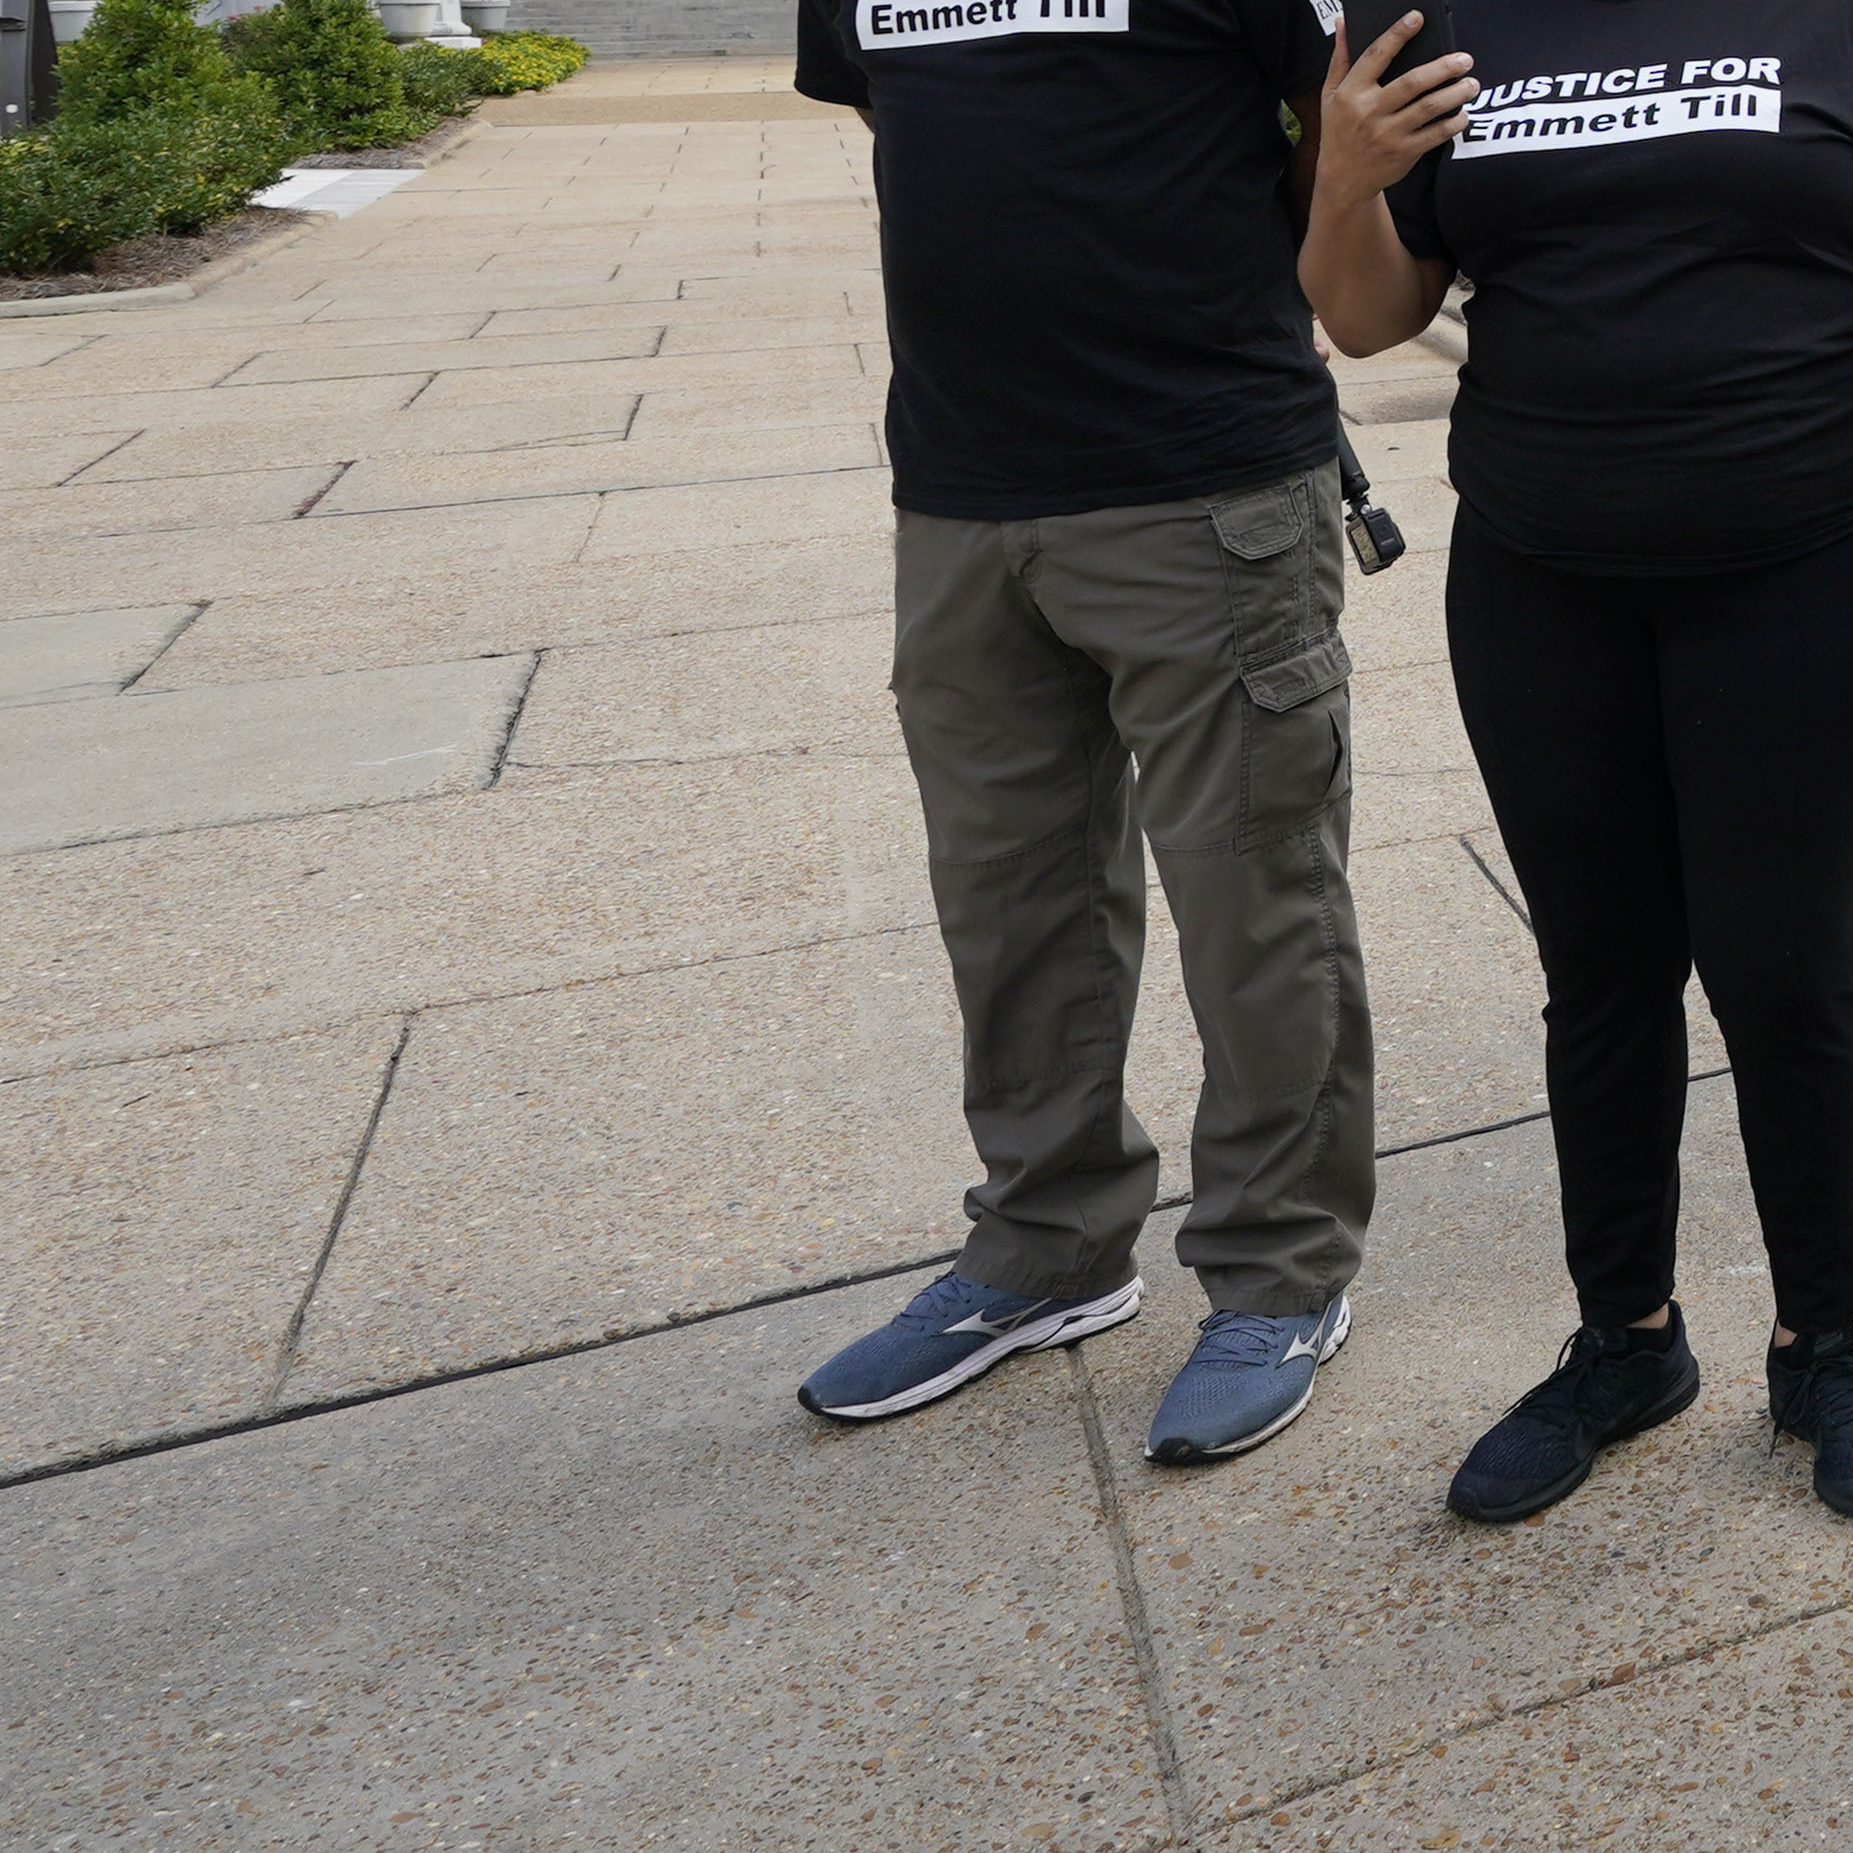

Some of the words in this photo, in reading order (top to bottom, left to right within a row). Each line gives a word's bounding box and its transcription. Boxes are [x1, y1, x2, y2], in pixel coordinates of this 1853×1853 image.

[1466, 63, 1668, 112] JUSTICE
[1680, 57, 1782, 85] FOR
[1462, 103, 1661, 142] Emmett
[1680, 92, 1758, 119] Till
